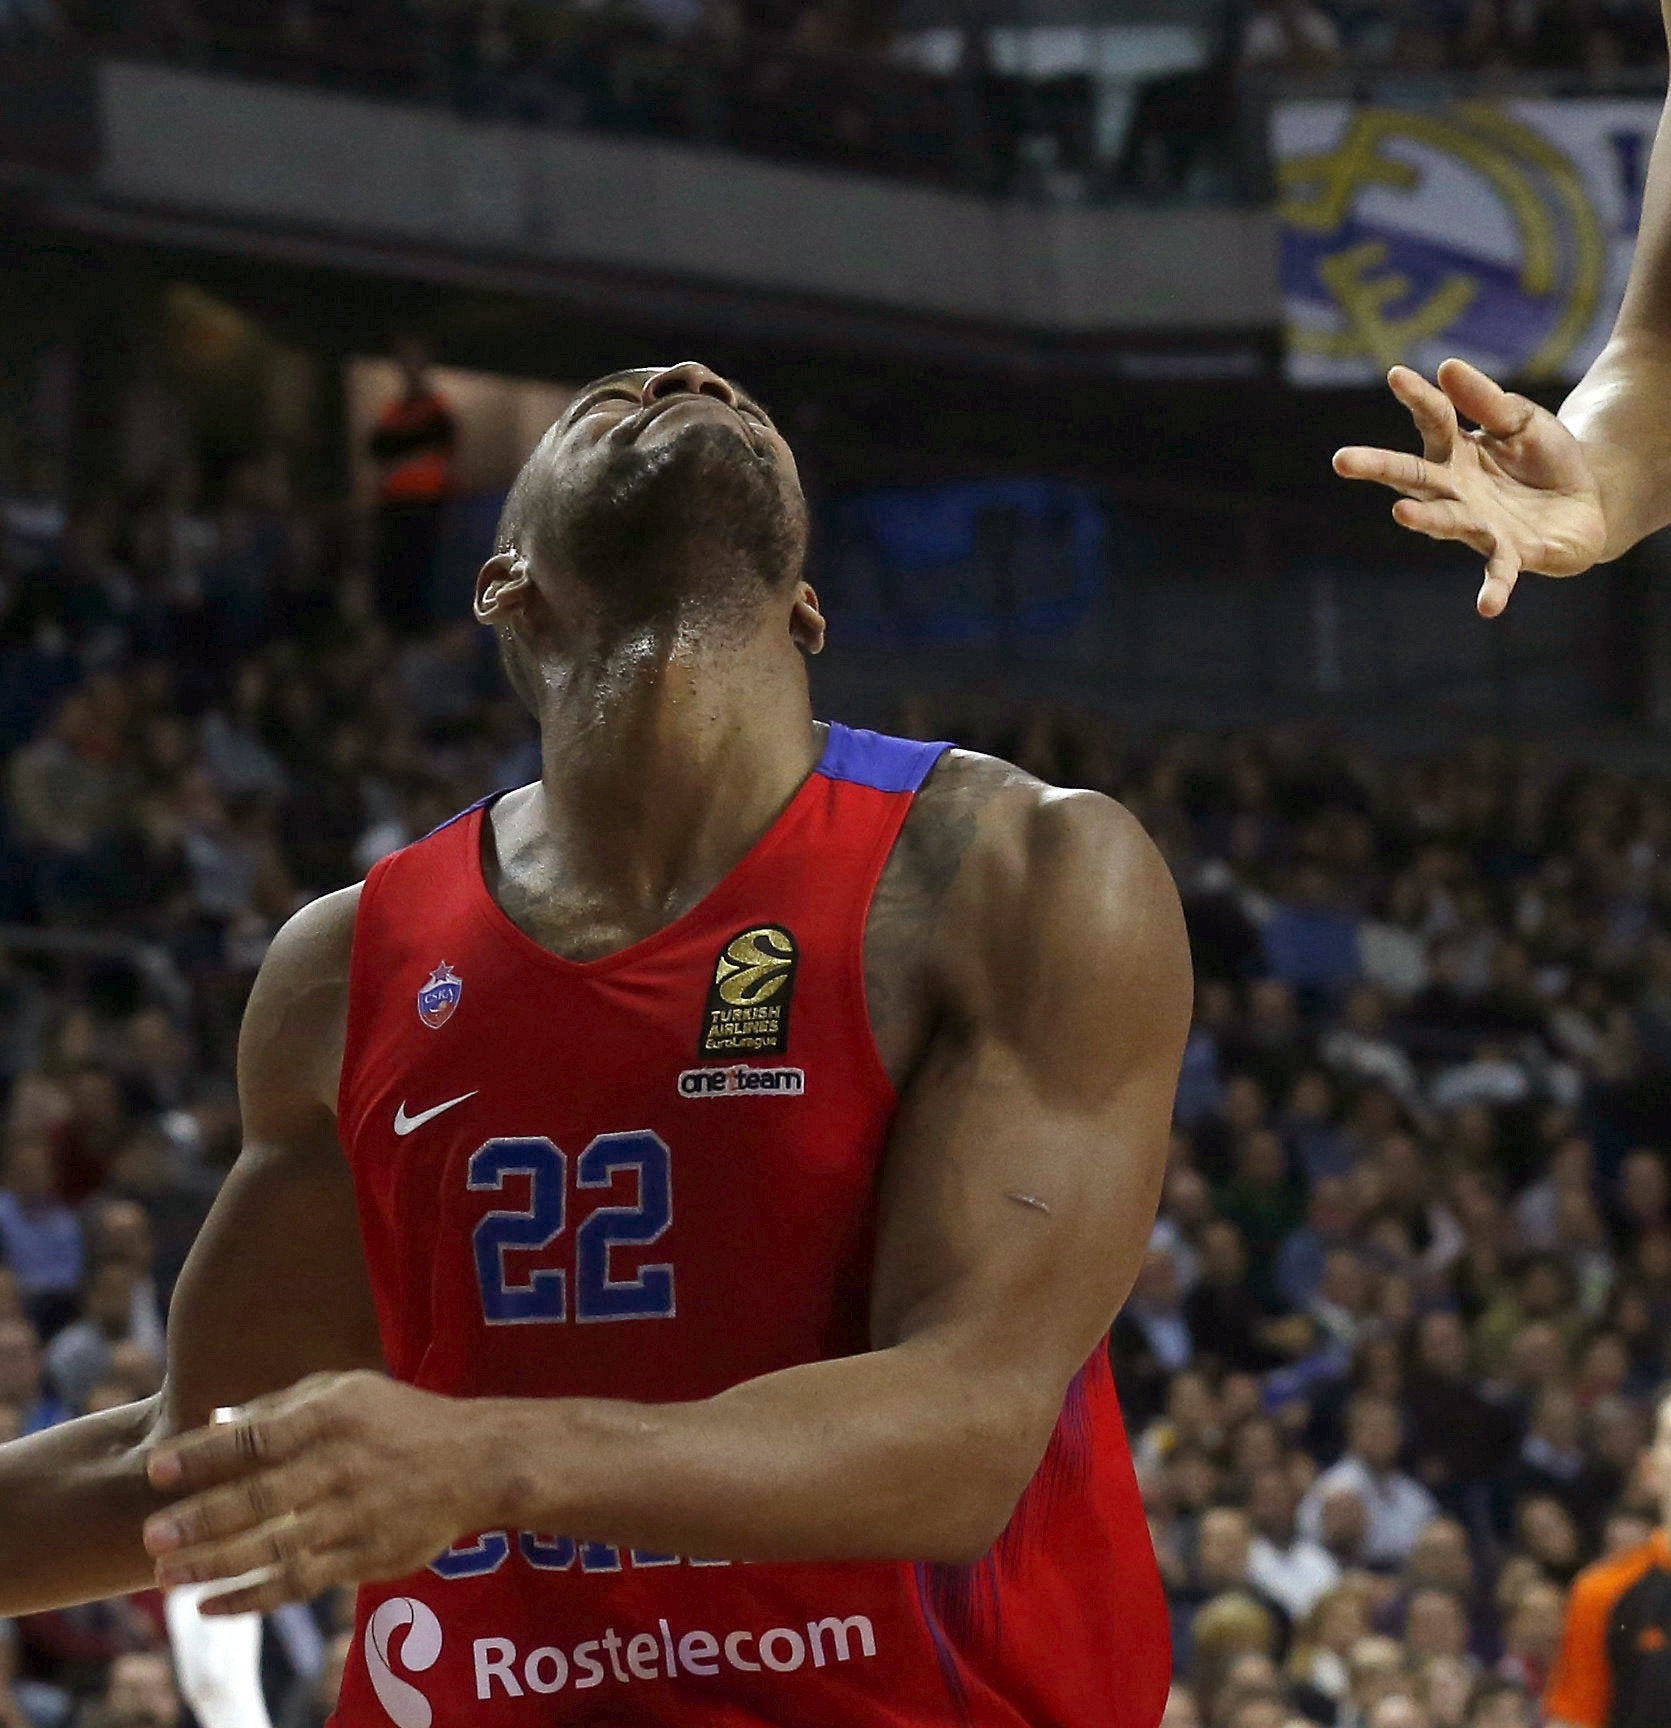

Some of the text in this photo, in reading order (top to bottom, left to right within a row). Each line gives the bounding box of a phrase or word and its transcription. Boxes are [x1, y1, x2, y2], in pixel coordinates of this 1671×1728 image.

[707, 1019, 779, 1038] AIRLINES
[710, 1006, 781, 1024] TURKISH
[466, 1128, 677, 1327] 22
[472, 1613, 878, 1701] Rostelecom
